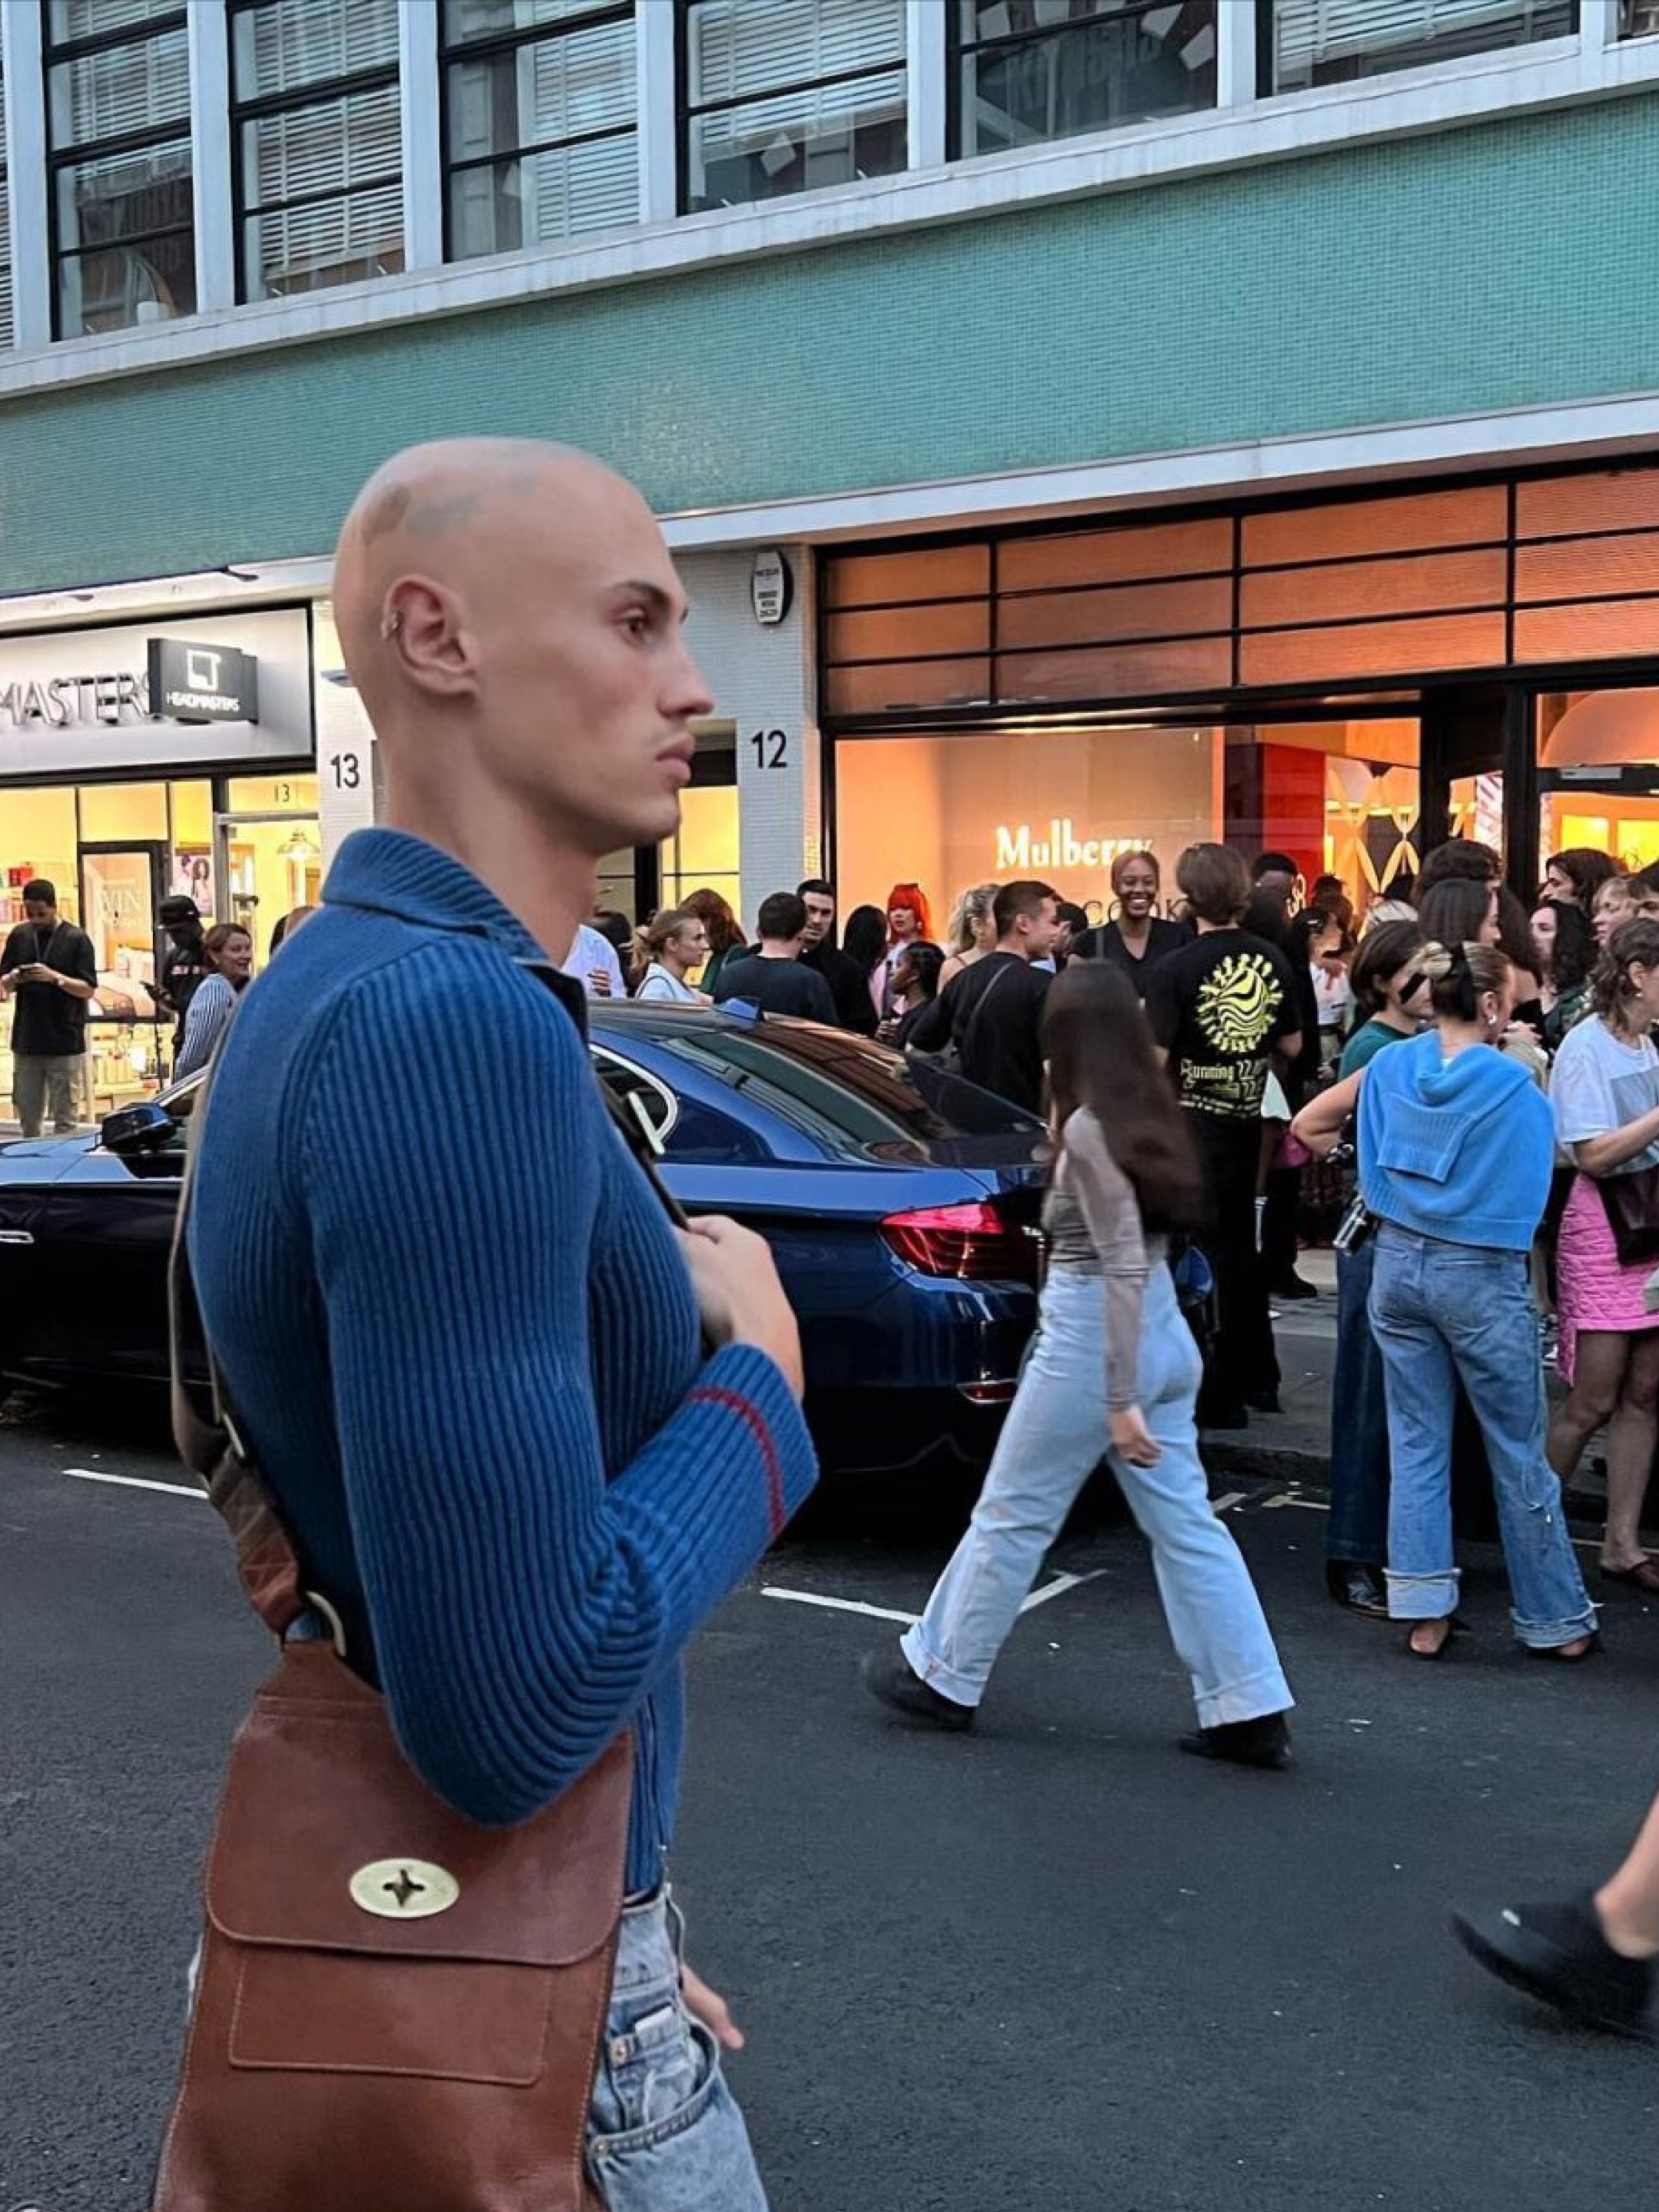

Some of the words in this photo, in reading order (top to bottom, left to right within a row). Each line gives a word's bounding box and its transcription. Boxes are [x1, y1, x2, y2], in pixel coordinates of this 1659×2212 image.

[0, 673, 150, 726] MASTER
[751, 729, 788, 769] 12
[330, 753, 360, 789] 13
[273, 783, 290, 803] 13
